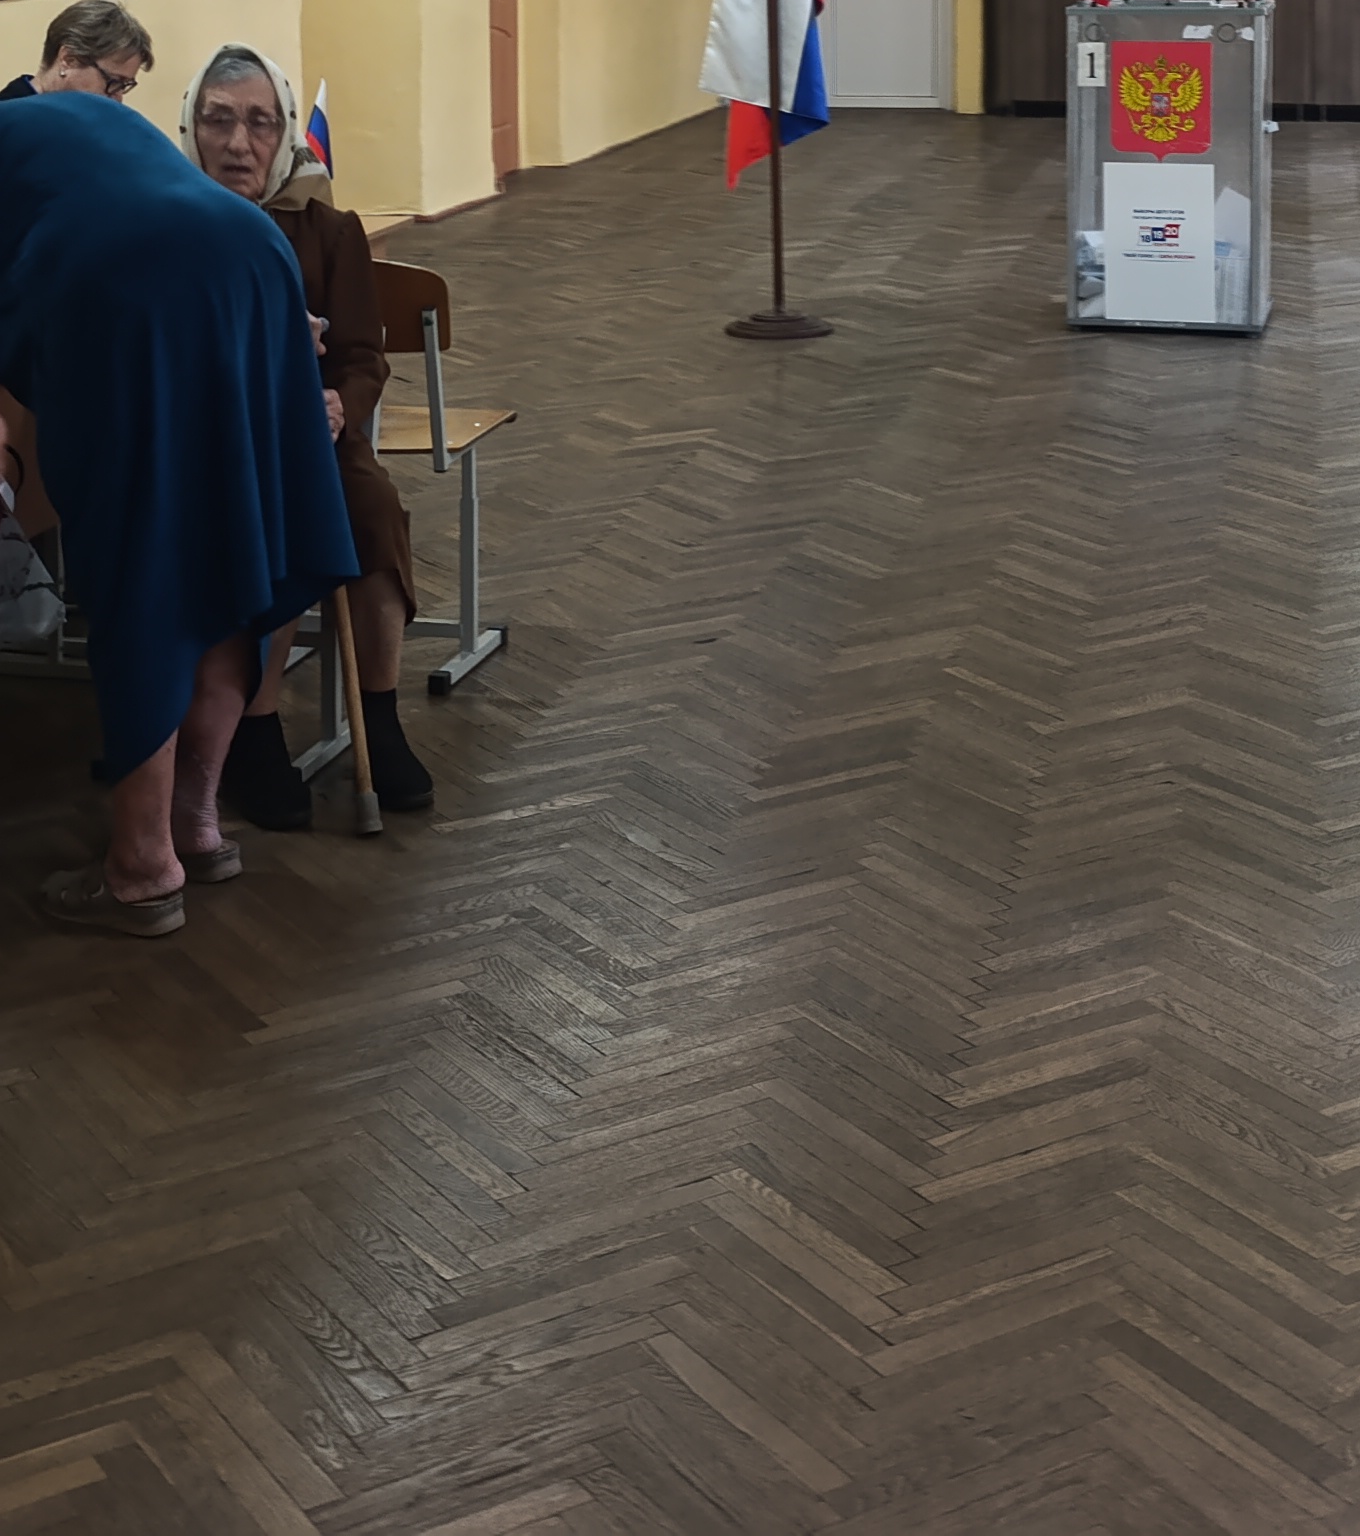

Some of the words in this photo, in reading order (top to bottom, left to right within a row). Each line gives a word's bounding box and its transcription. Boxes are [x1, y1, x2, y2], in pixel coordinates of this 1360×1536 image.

[1086, 52, 1097, 78] 1
[1141, 234, 1152, 243] 18
[1153, 230, 1164, 239] 19
[1164, 226, 1178, 236] 20
